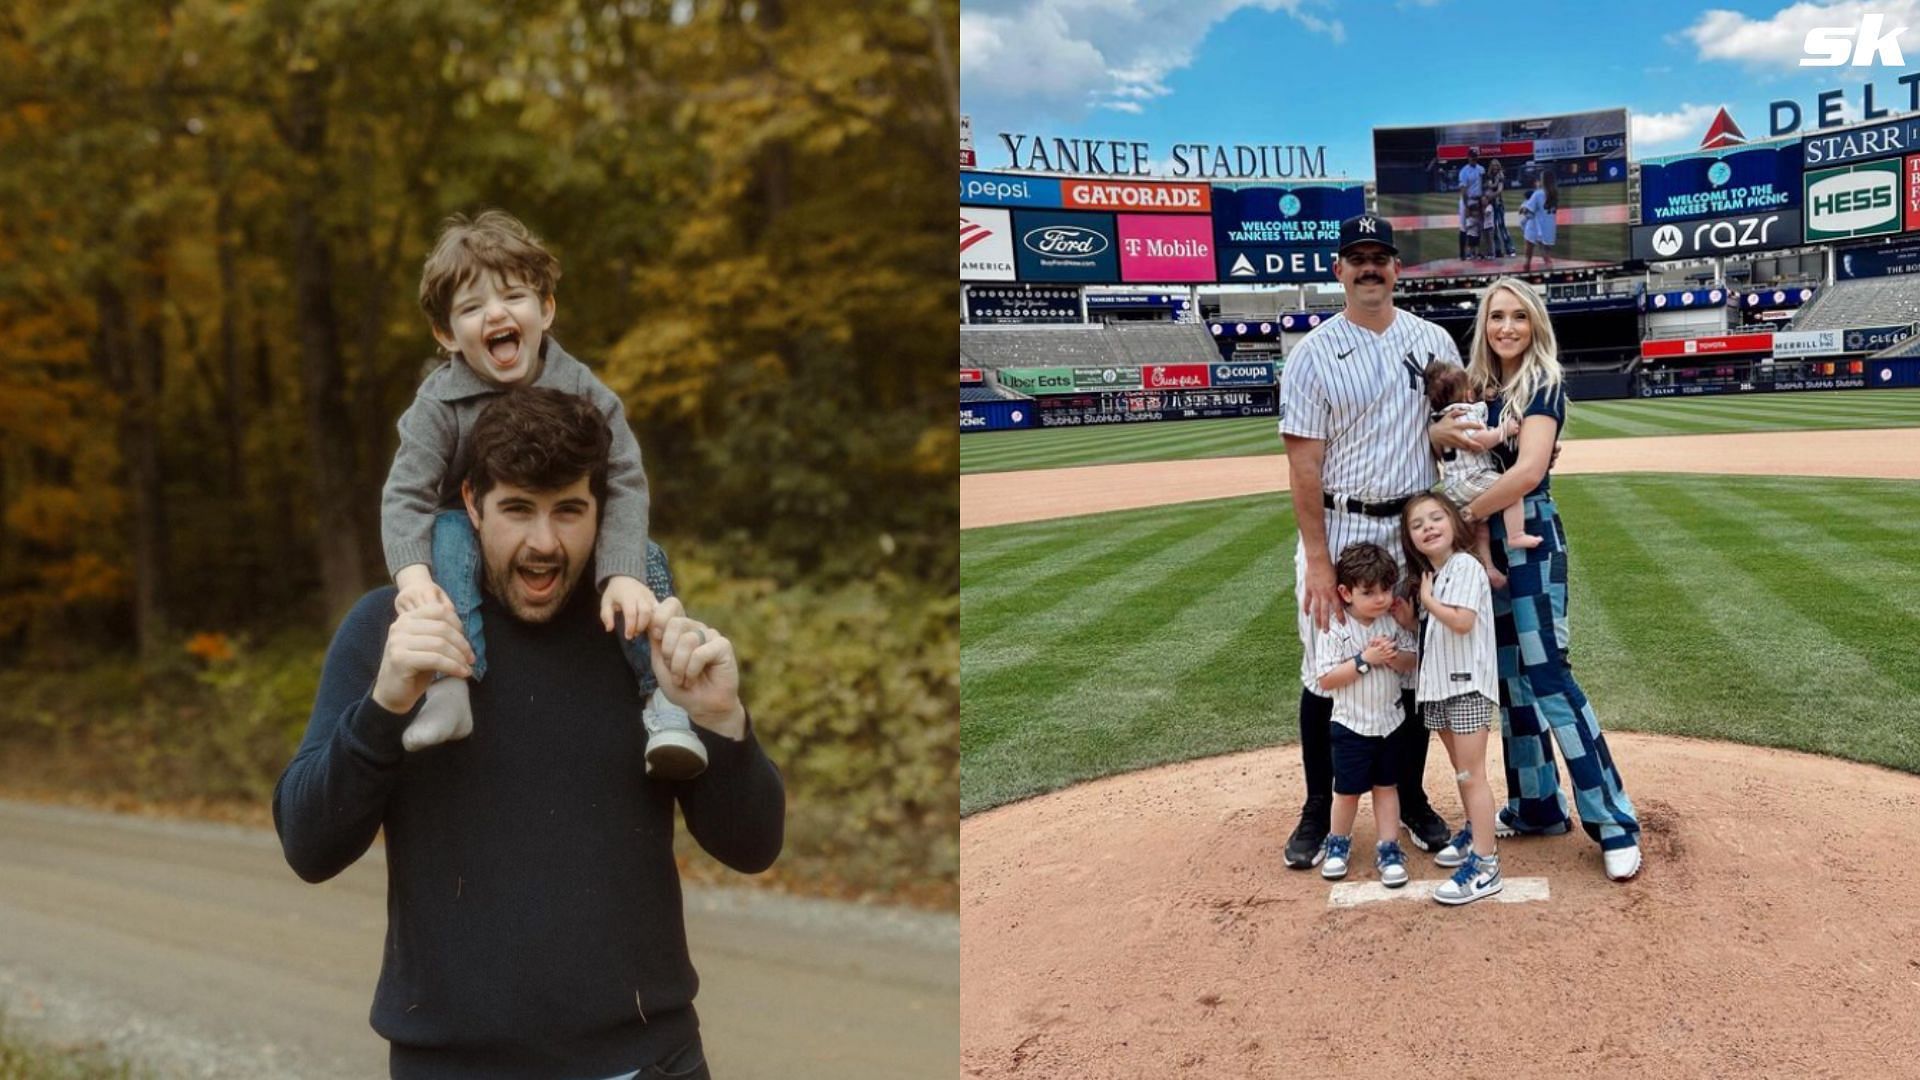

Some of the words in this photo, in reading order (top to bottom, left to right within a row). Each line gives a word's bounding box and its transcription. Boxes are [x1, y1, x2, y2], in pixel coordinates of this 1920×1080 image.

[1807, 126, 1904, 163] STARR
[999, 133, 1151, 175] YANKEE
[1173, 144, 1327, 178] STADIUM
[968, 181, 1029, 200] pepsi
[1072, 185, 1201, 207] GATORADE
[1668, 190, 1727, 206] WELCOME
[1731, 187, 1747, 198] TO
[1750, 184, 1773, 196] THE
[1814, 185, 1891, 216] HESS
[1654, 203, 1708, 218] YANKEES
[1711, 198, 1743, 212] TEAM
[1747, 192, 1789, 208] PICNIC
[1228, 231, 1280, 241] YANKEES
[1283, 231, 1314, 240] TEAM
[1242, 221, 1298, 231] WELCOME
[1302, 221, 1317, 231] TO
[1320, 221, 1340, 230] THE
[1694, 215, 1778, 251] razr
[1039, 229, 1094, 253] Ford
[1147, 239, 1208, 257] Mobile
[961, 261, 1012, 271] AMERICA
[1775, 340, 1817, 350] MERRILL
[1004, 375, 1034, 388] Uber
[1039, 376, 1071, 387] Eats
[1232, 366, 1267, 379] coupa
